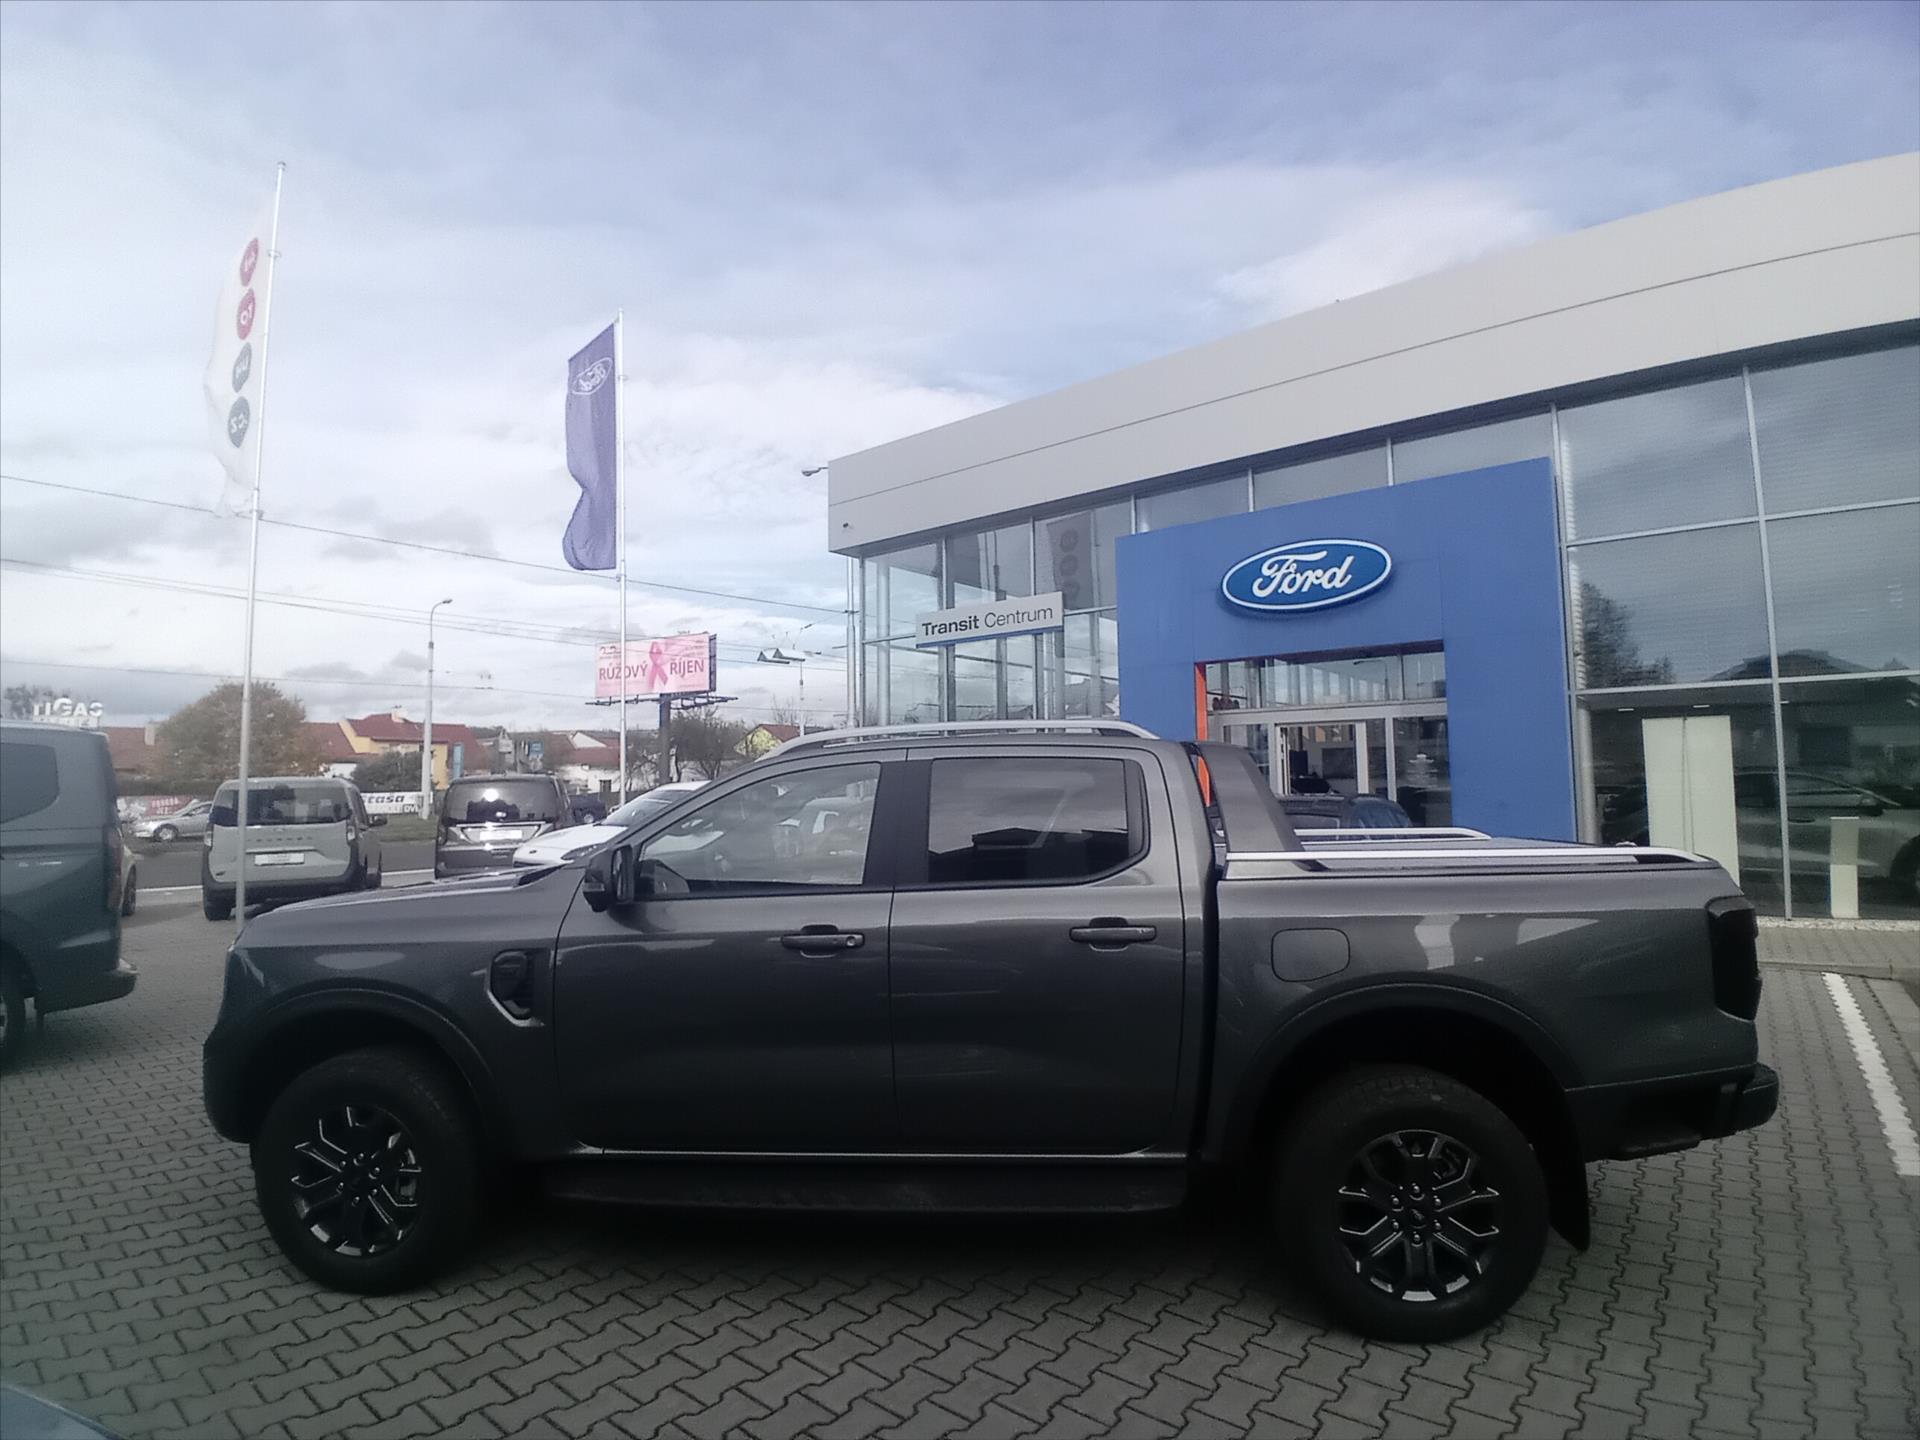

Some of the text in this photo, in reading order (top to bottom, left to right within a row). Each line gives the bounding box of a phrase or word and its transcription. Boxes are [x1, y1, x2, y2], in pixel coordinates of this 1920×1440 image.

[1252, 550, 1355, 597] Ford
[922, 607, 1053, 636] Transit Centrum
[670, 658, 705, 678] ŘÍJEN
